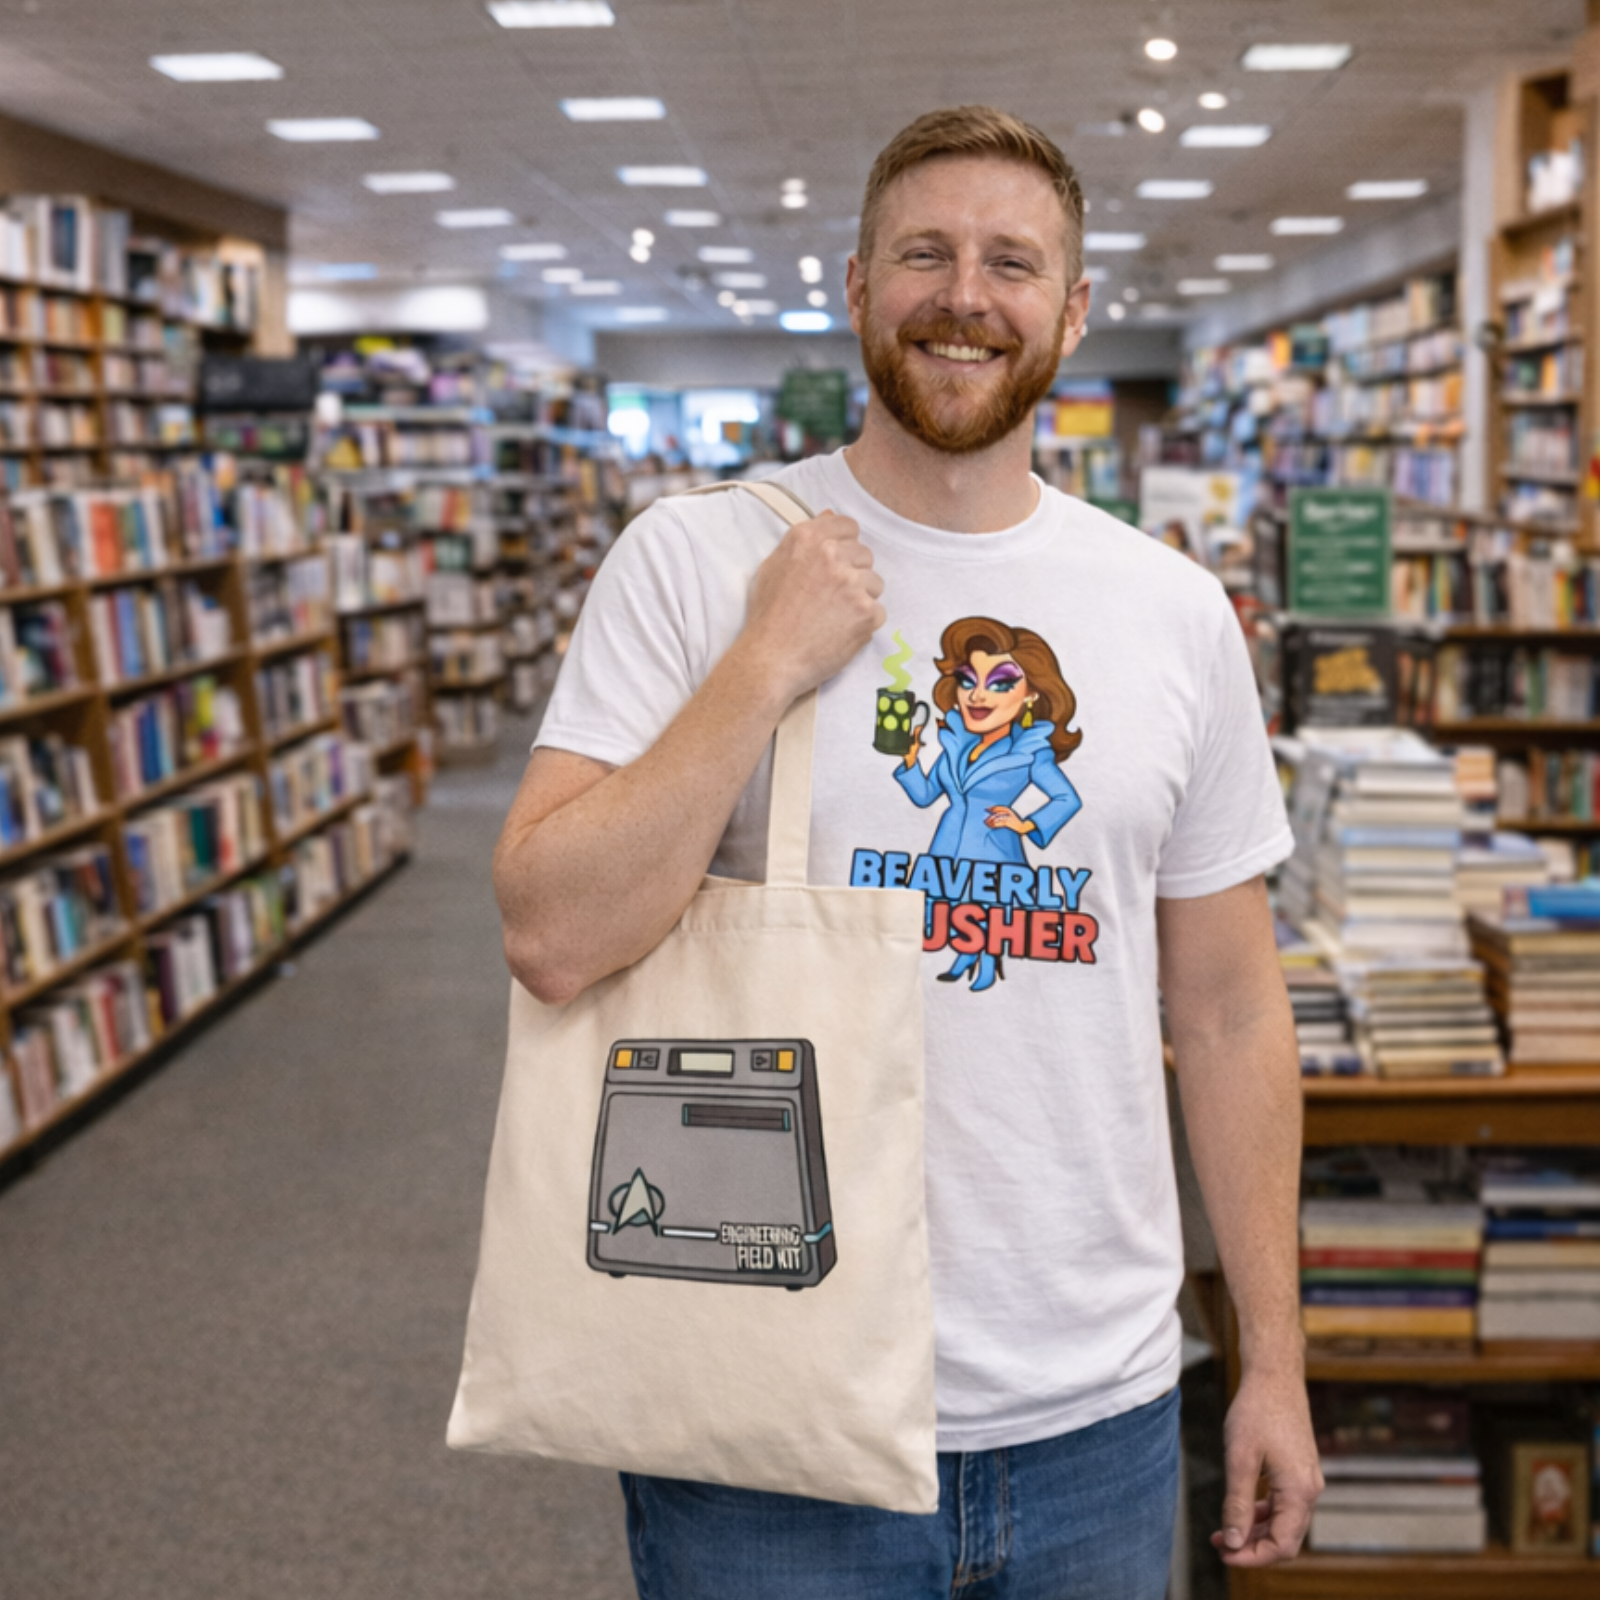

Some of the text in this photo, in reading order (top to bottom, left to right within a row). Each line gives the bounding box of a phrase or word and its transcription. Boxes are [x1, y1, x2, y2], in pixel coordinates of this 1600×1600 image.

[850, 848, 1092, 911] BEAVERLY
[922, 901, 1098, 964] USHER
[738, 1245, 801, 1269] FIELD KIT
